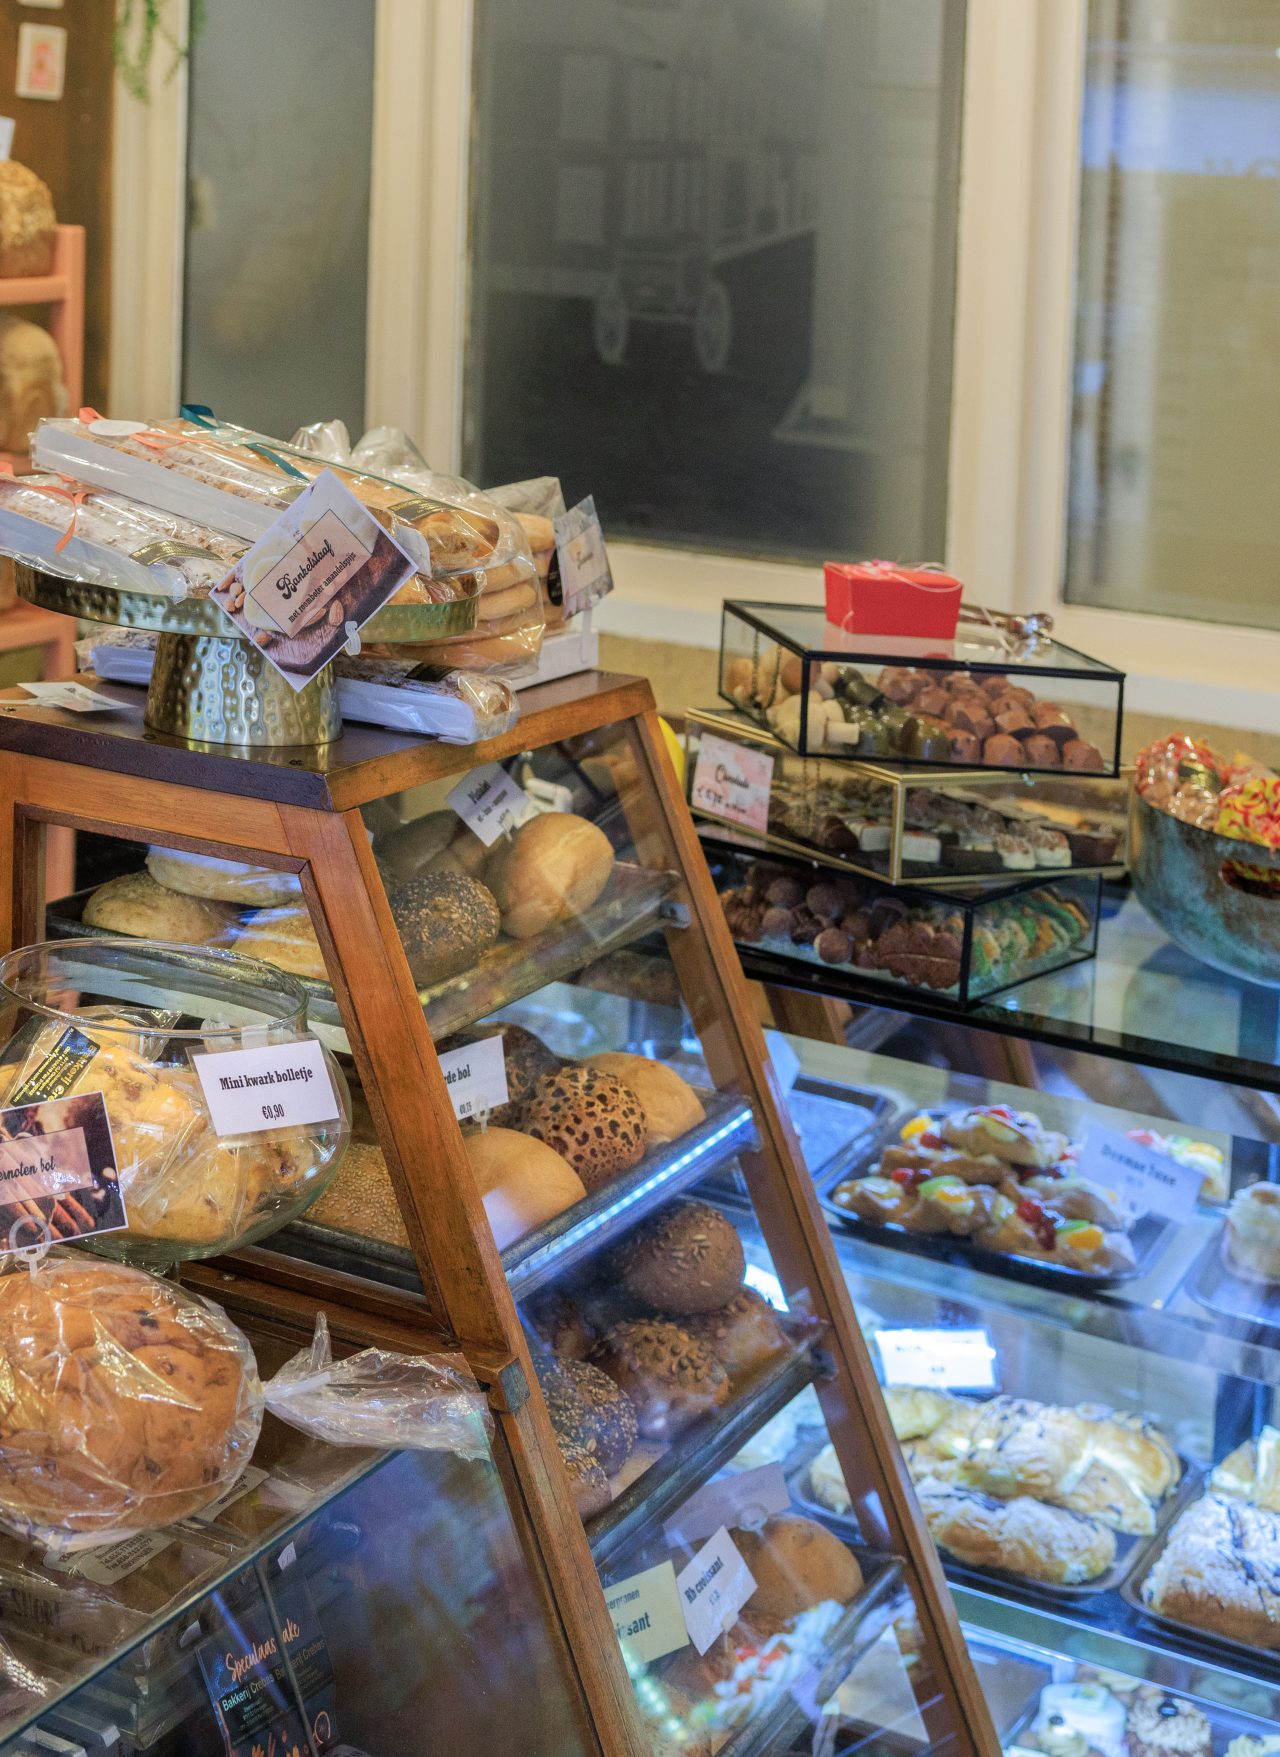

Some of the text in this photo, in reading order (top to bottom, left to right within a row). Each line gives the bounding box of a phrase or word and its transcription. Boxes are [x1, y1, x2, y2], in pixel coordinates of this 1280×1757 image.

[276, 539, 335, 600] Banketstaaf
[288, 612, 301, 623] met
[299, 584, 324, 613] roomboter
[219, 1066, 313, 1091] Mini kwark bolletje
[457, 1064, 471, 1080] bol
[261, 1103, 285, 1121] €0,90
[40, 1155, 56, 1173] bol
[695, 1556, 724, 1593] croissant
[282, 1618, 300, 1643] ake
[221, 1689, 253, 1712] Bakkerij
